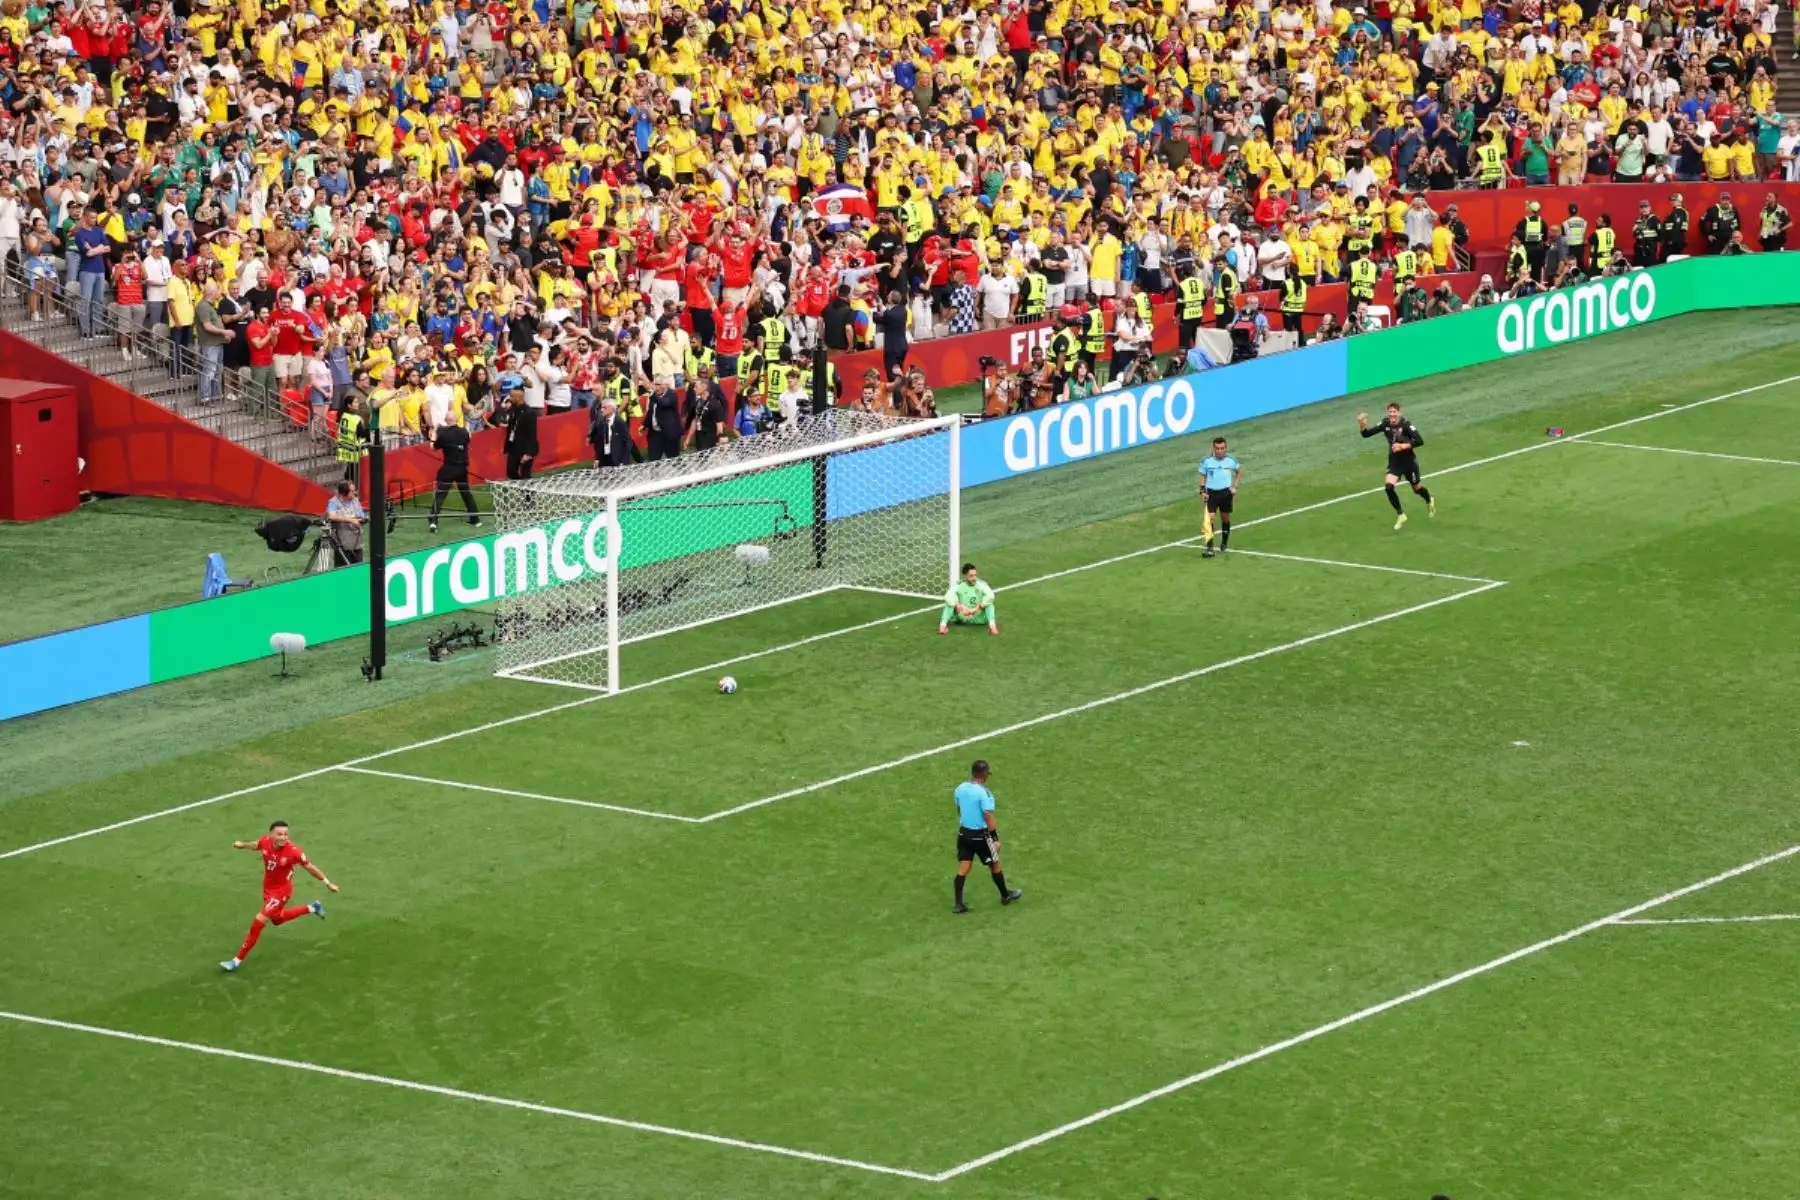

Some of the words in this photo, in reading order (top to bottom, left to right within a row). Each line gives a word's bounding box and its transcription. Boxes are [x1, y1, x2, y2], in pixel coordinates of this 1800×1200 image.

[1010, 326, 1054, 365] FIF
[1497, 272, 1656, 353] aramco
[1004, 380, 1195, 472] aramco
[385, 511, 623, 622] aramco
